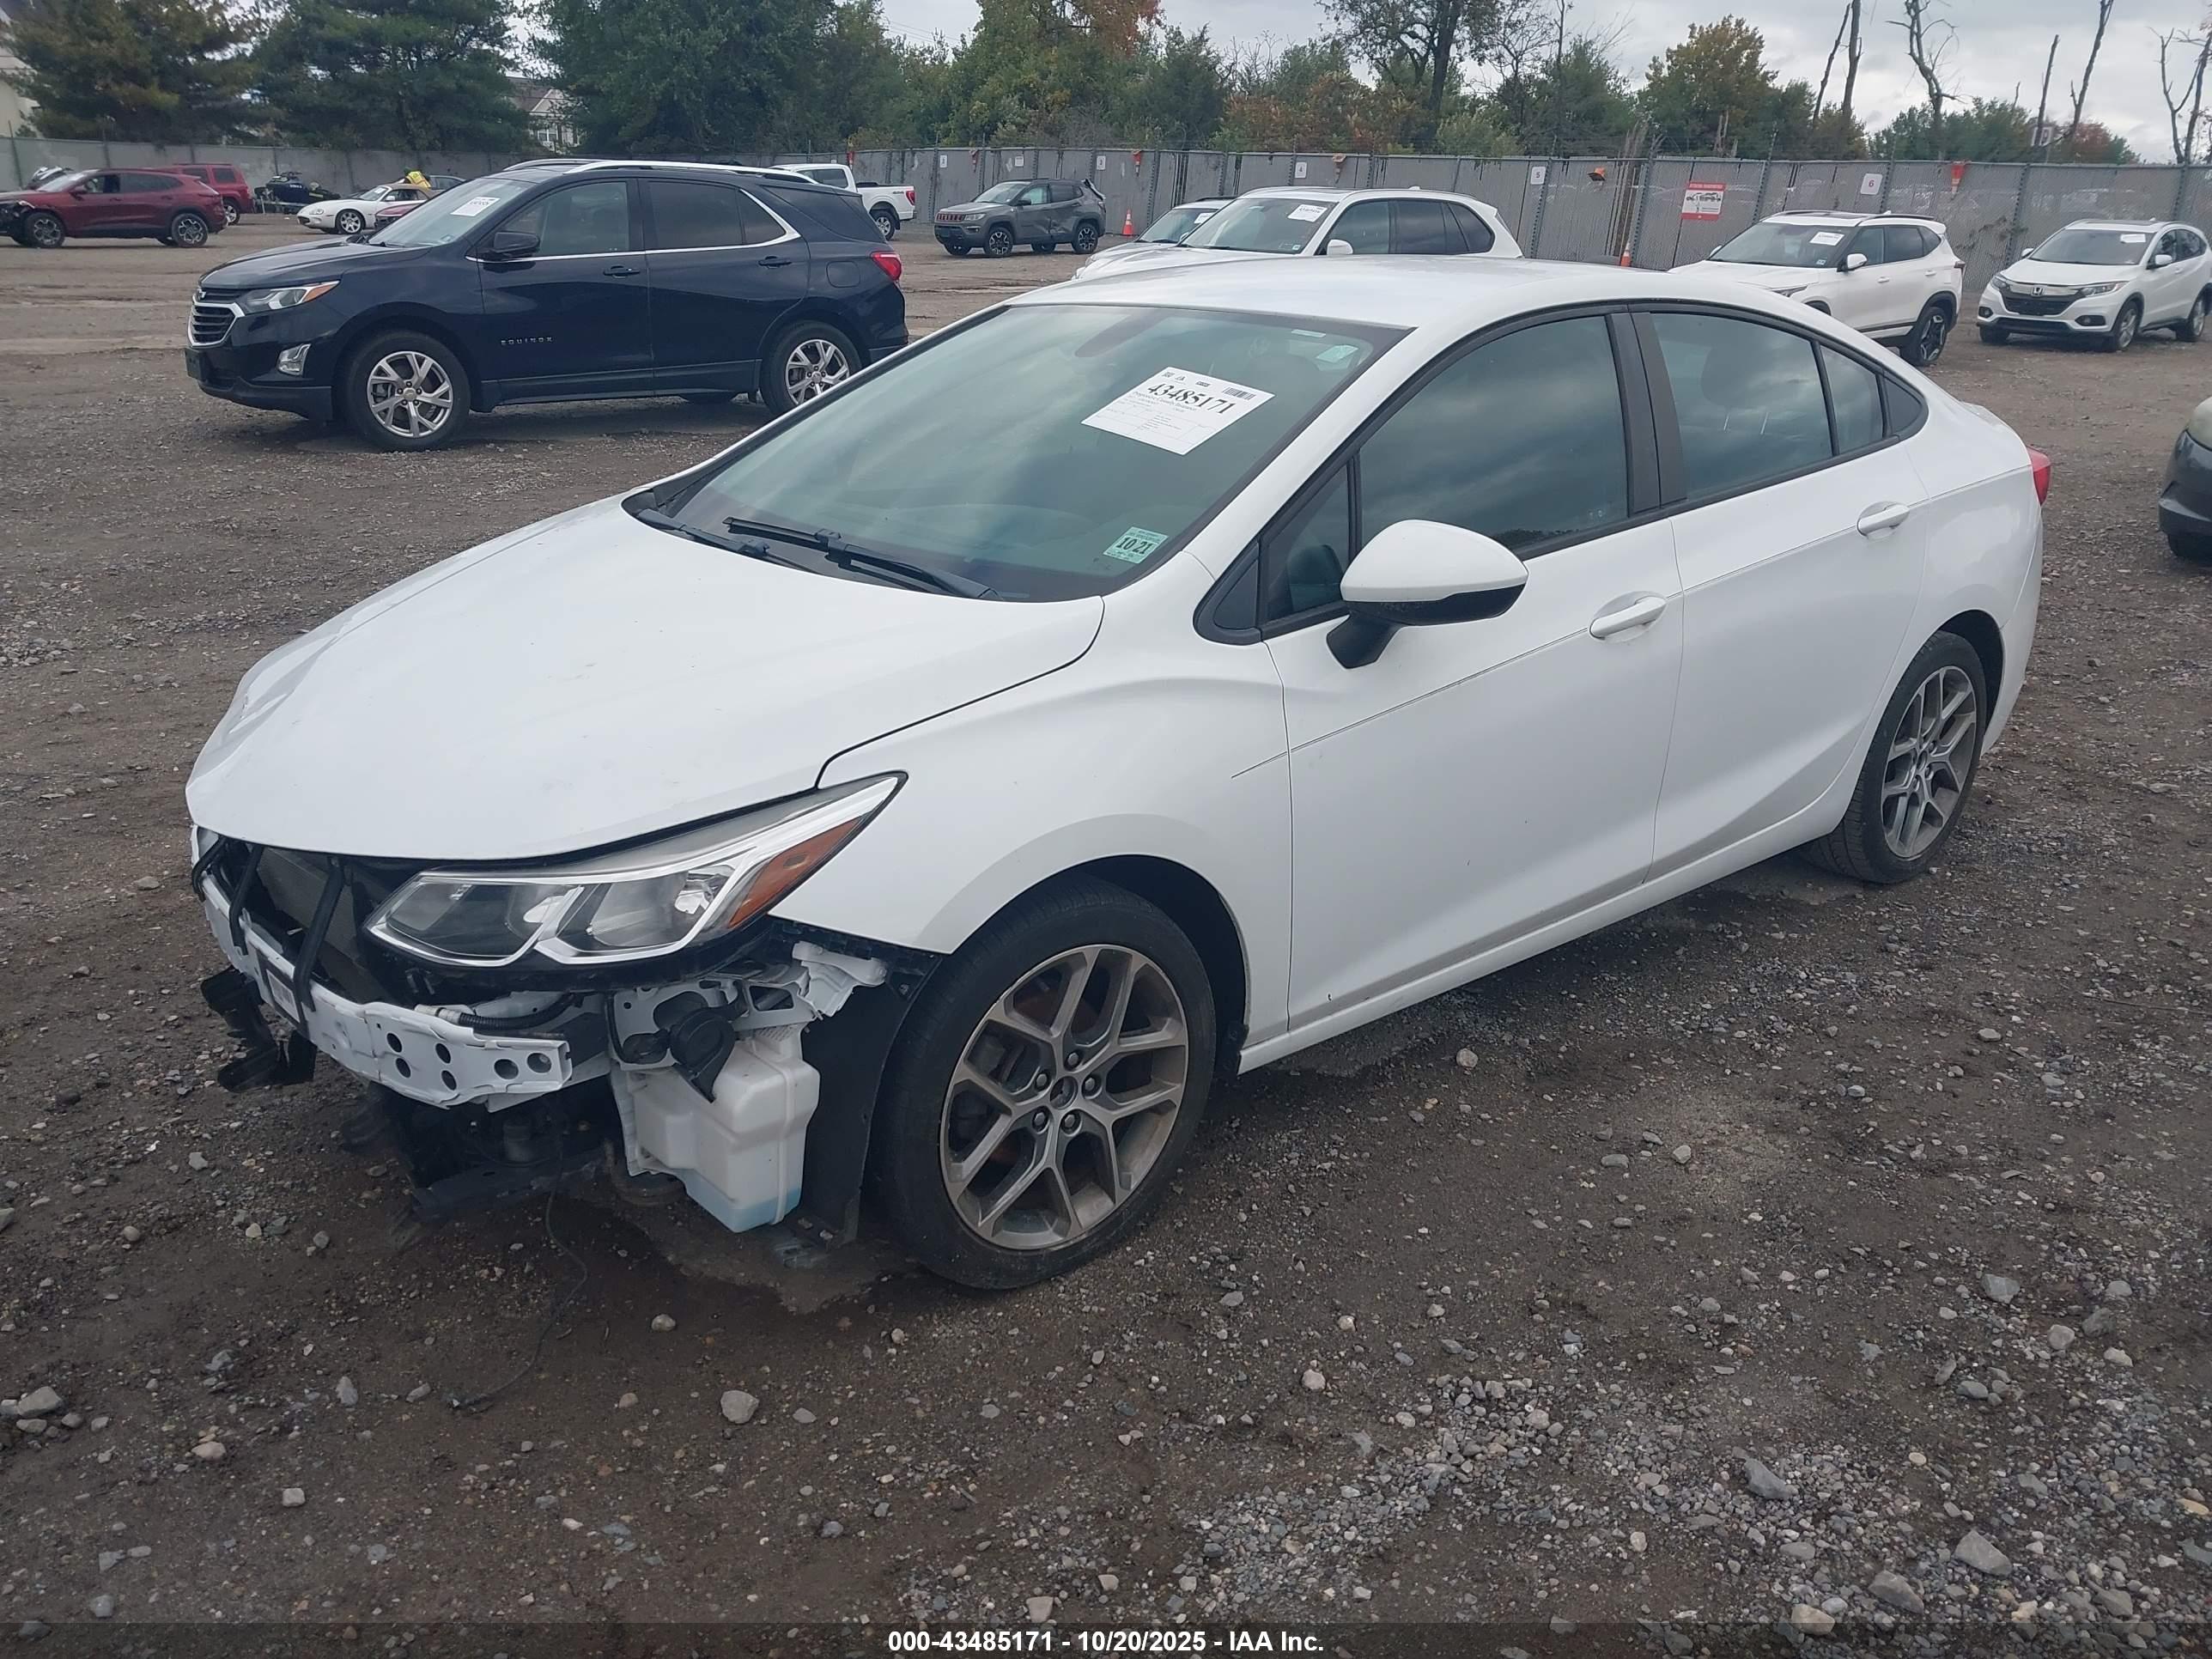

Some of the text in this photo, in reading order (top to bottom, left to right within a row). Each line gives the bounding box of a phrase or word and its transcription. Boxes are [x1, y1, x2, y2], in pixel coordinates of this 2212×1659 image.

[501, 337, 553, 345] EQUINOX
[1147, 383, 1237, 414] 43485171
[1115, 537, 1154, 555] 10 21
